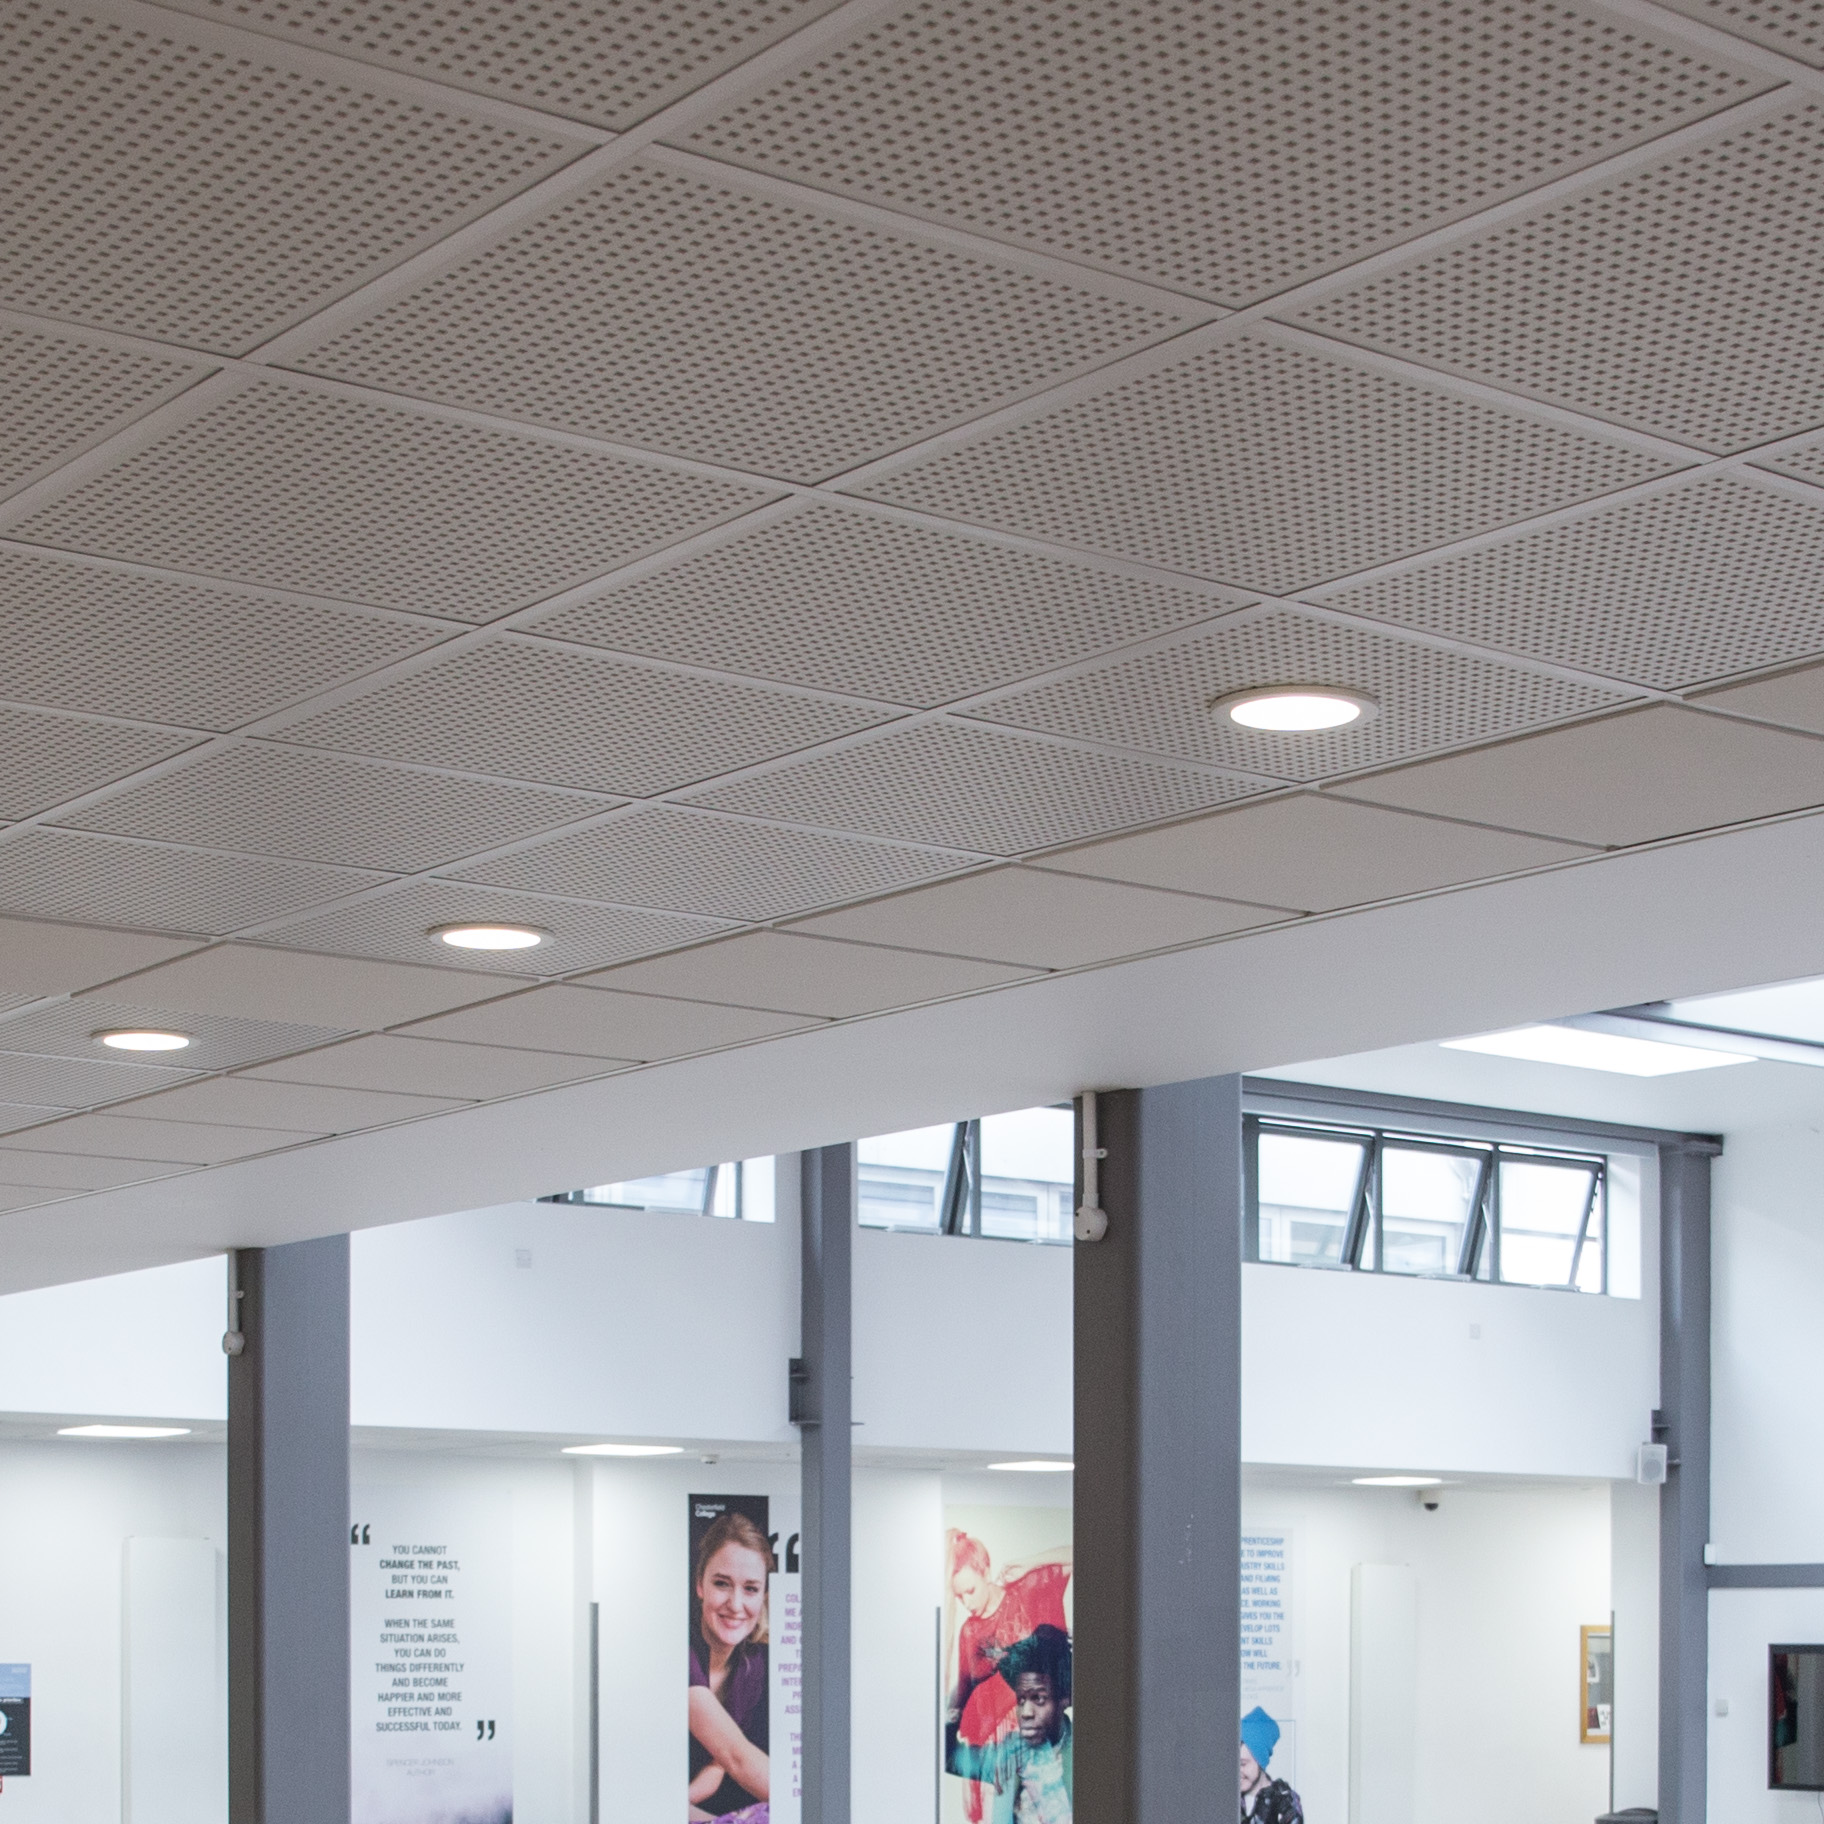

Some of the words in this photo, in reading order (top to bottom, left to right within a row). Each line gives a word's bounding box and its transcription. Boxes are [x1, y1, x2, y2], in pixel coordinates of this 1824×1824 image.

[392, 1545, 410, 1555] YOU
[412, 1545, 447, 1555] CANNOT
[379, 1559, 415, 1569] CHANGE
[418, 1560, 433, 1569] THE
[436, 1561, 461, 1571] PAST,
[391, 1574, 408, 1584] BUT
[411, 1574, 428, 1584] YOU
[430, 1575, 448, 1584] CAN
[385, 1589, 414, 1599] LEARN
[417, 1589, 442, 1599] FROM
[444, 1589, 454, 1599] IT.
[384, 1618, 410, 1628] WHEN
[412, 1618, 428, 1628] THE
[431, 1618, 455, 1628] SAME
[379, 1633, 425, 1643] SITUATION
[427, 1633, 460, 1644] ARISES,
[394, 1648, 411, 1658] YOU
[413, 1648, 432, 1658] CAN
[434, 1648, 447, 1658] DO
[375, 1662, 407, 1672] THINGS
[409, 1662, 465, 1672] DIFFERENTLY
[392, 1677, 410, 1687] AND
[412, 1677, 448, 1687] BECOME
[377, 1692, 415, 1702] HAPPIER
[417, 1692, 435, 1701] AND
[437, 1692, 462, 1701] MORE
[387, 1707, 432, 1717] EFFECTIVE
[434, 1706, 453, 1716] AND
[375, 1721, 430, 1732] SUCCESSFUL
[433, 1721, 462, 1731] TODAY.
